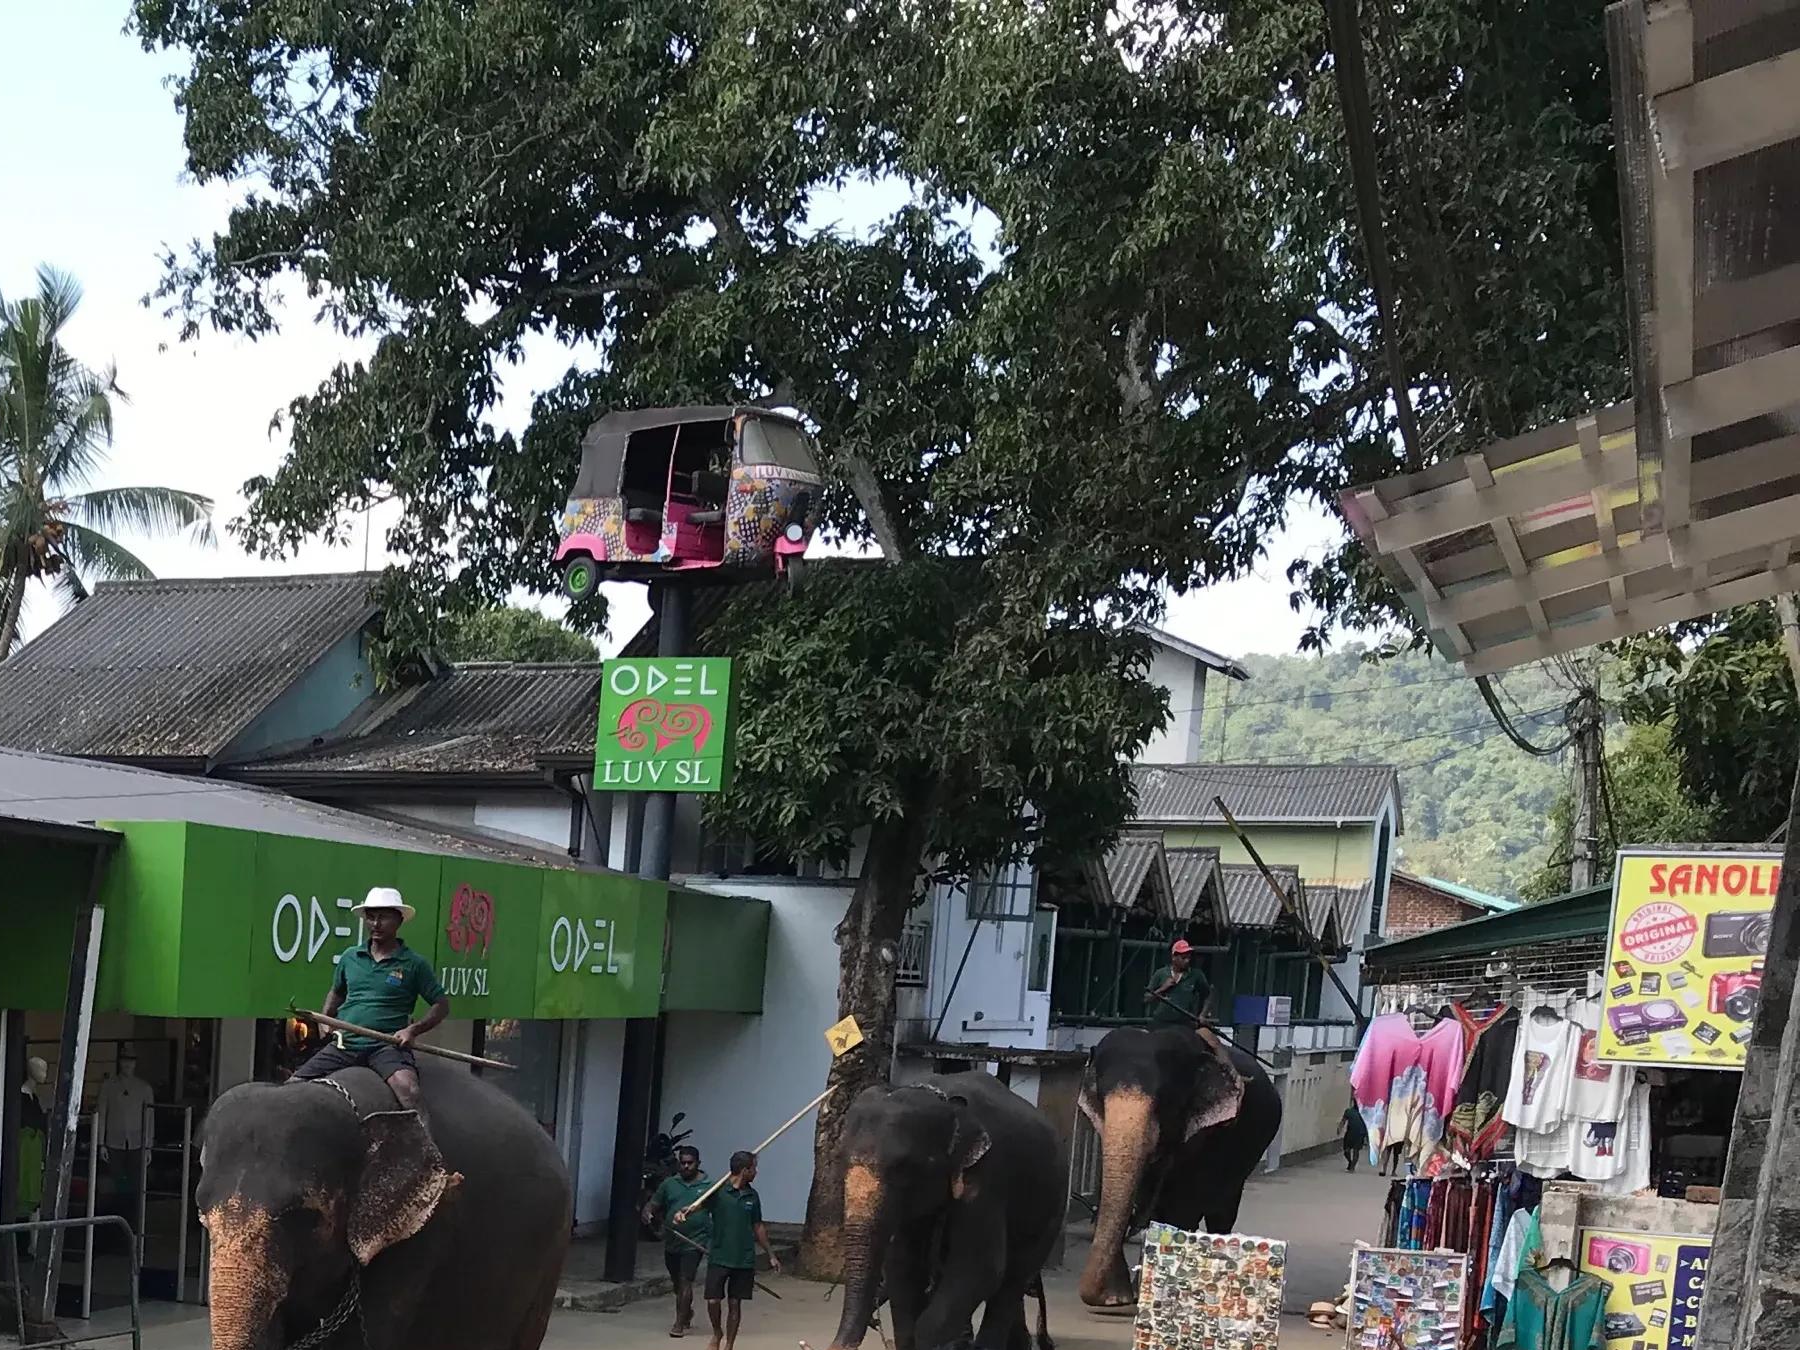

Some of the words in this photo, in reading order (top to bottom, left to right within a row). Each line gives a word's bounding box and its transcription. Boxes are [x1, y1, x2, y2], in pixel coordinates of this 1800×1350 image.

[611, 664, 718, 696] ODEL
[602, 760, 668, 784] LUV
[674, 760, 711, 784] SL
[550, 916, 618, 973] ODEL
[1624, 920, 1694, 947] ORIGINAL
[441, 967, 473, 996] LUV
[472, 968, 489, 996] SL
